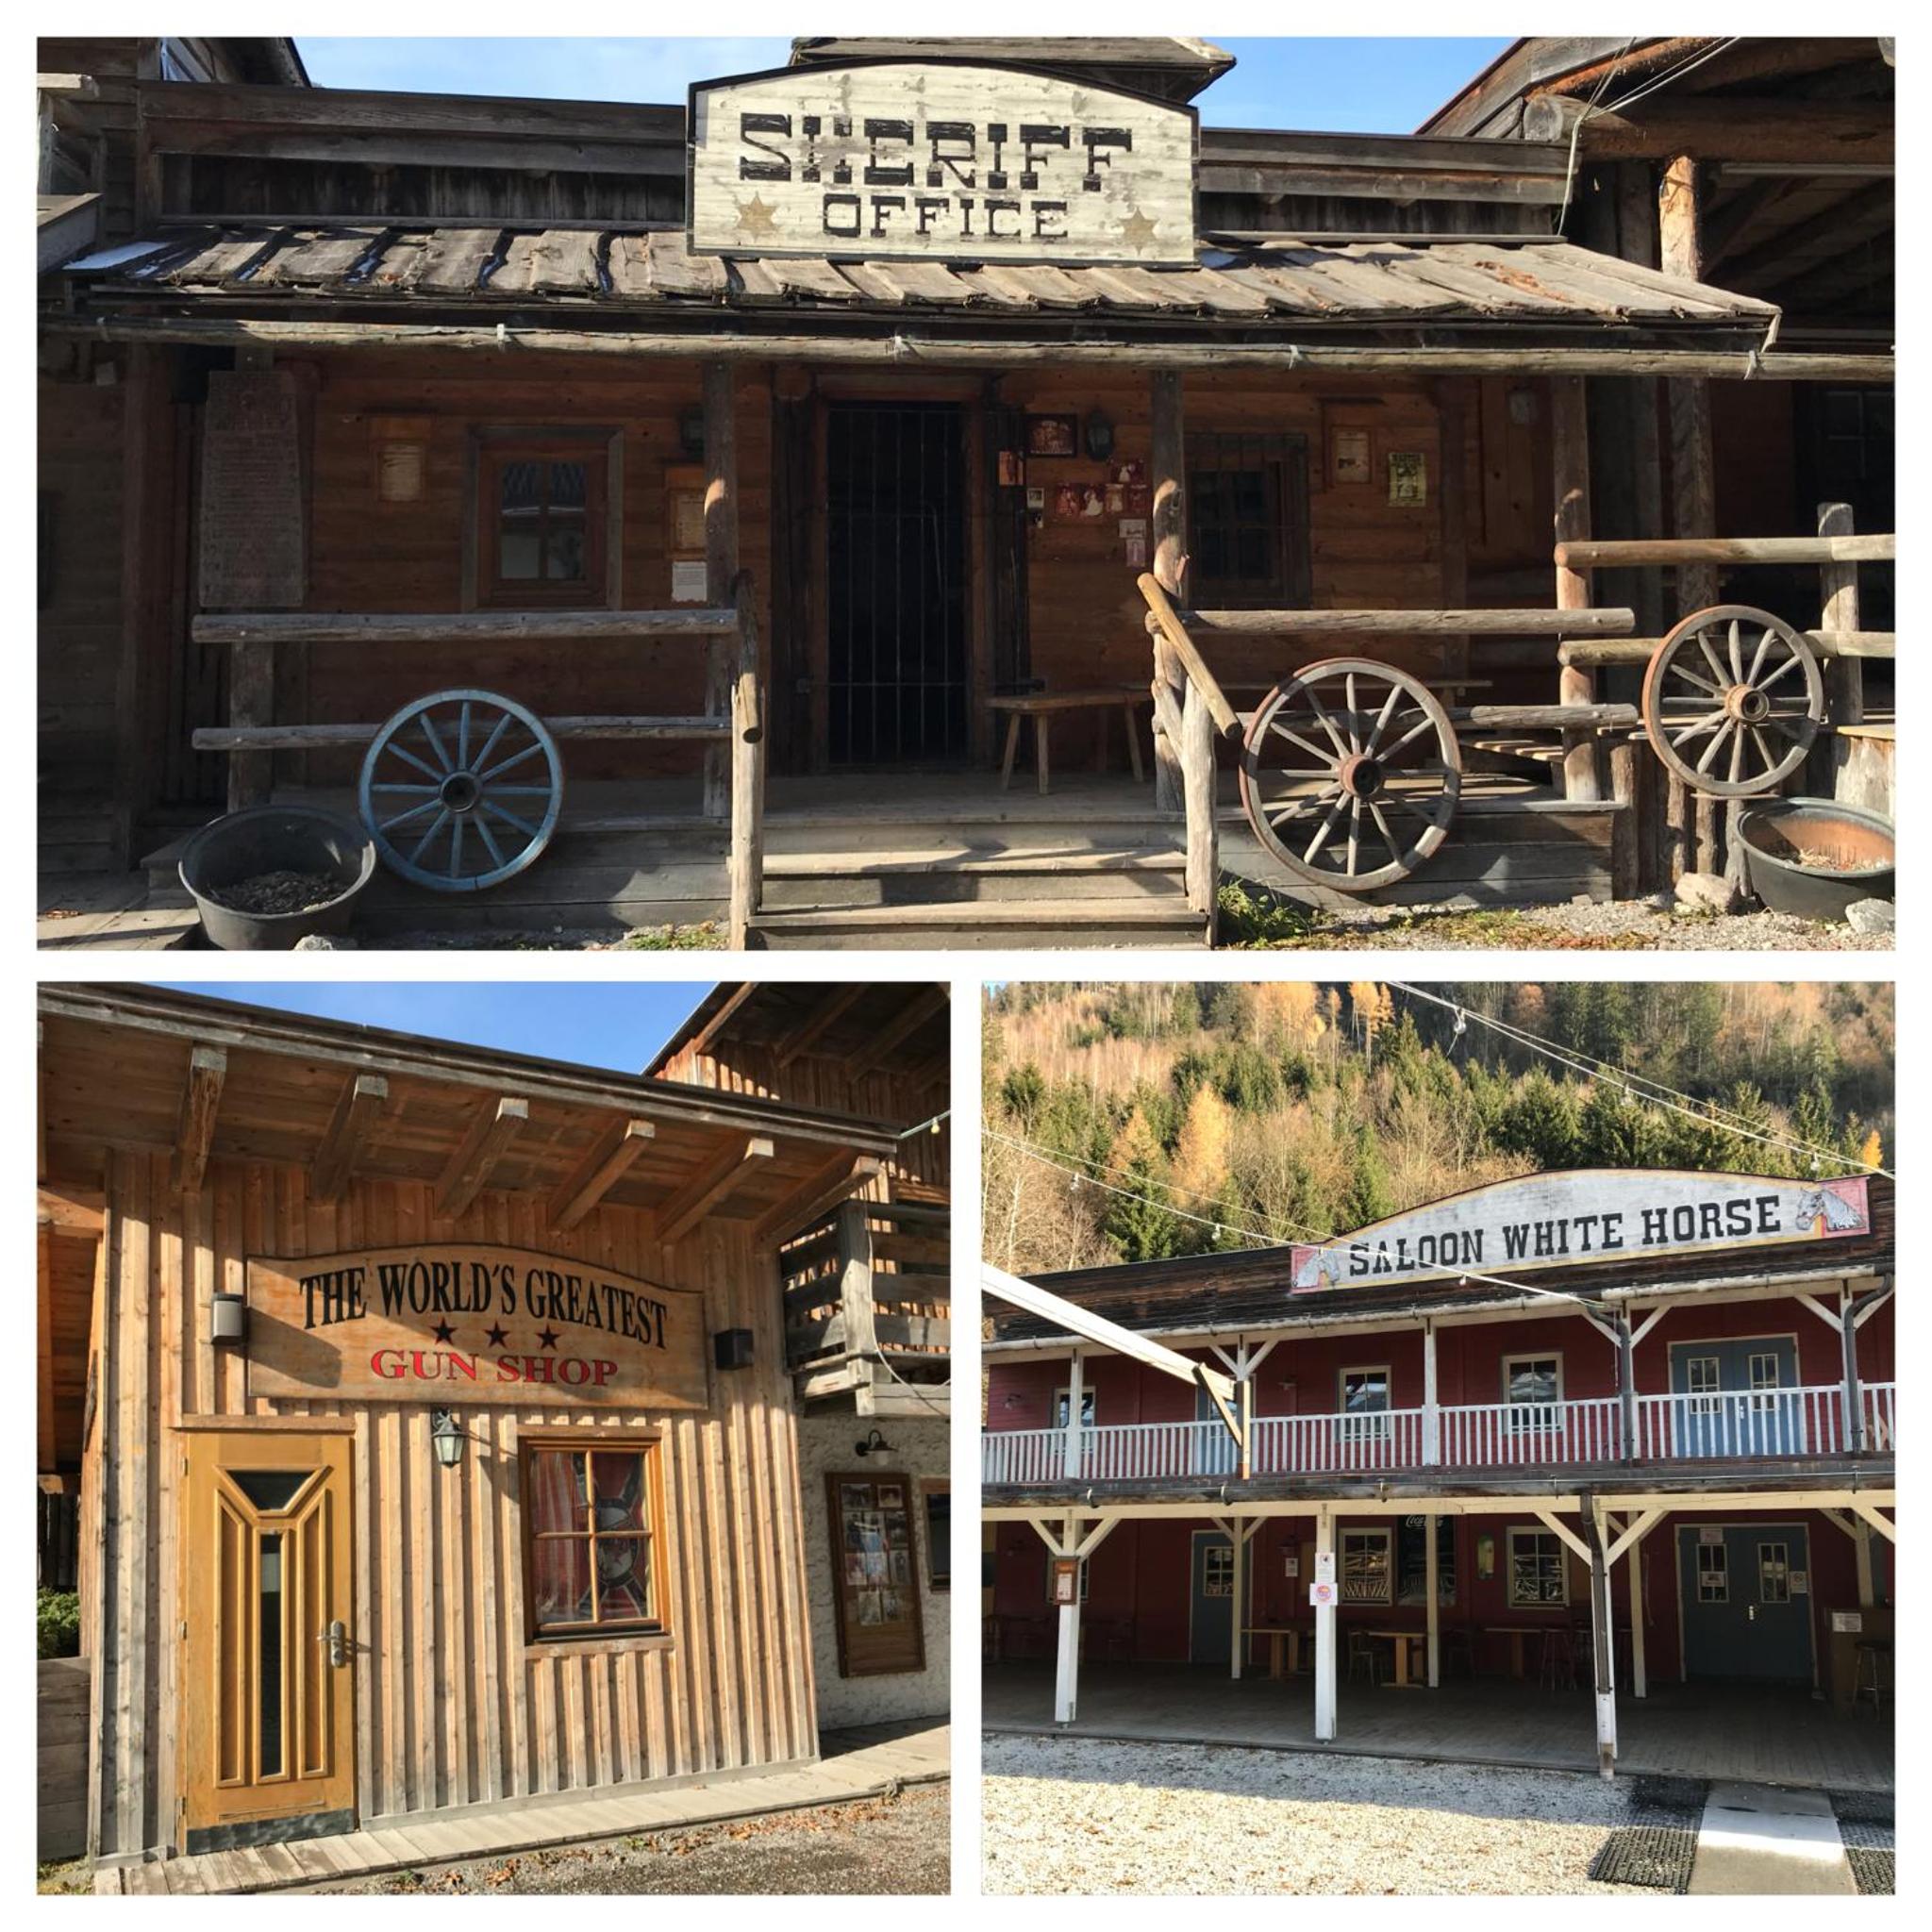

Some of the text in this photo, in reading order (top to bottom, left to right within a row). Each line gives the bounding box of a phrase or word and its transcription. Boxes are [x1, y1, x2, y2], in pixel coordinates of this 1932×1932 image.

[741, 113, 1132, 192] SHERIFF
[823, 194, 1068, 238] OFFICE
[1350, 1195, 1781, 1277] SALOON WHITE HORSE
[300, 1261, 668, 1349] THE WORLD'S GREATEST
[371, 1349, 619, 1387] GUN SHOP
